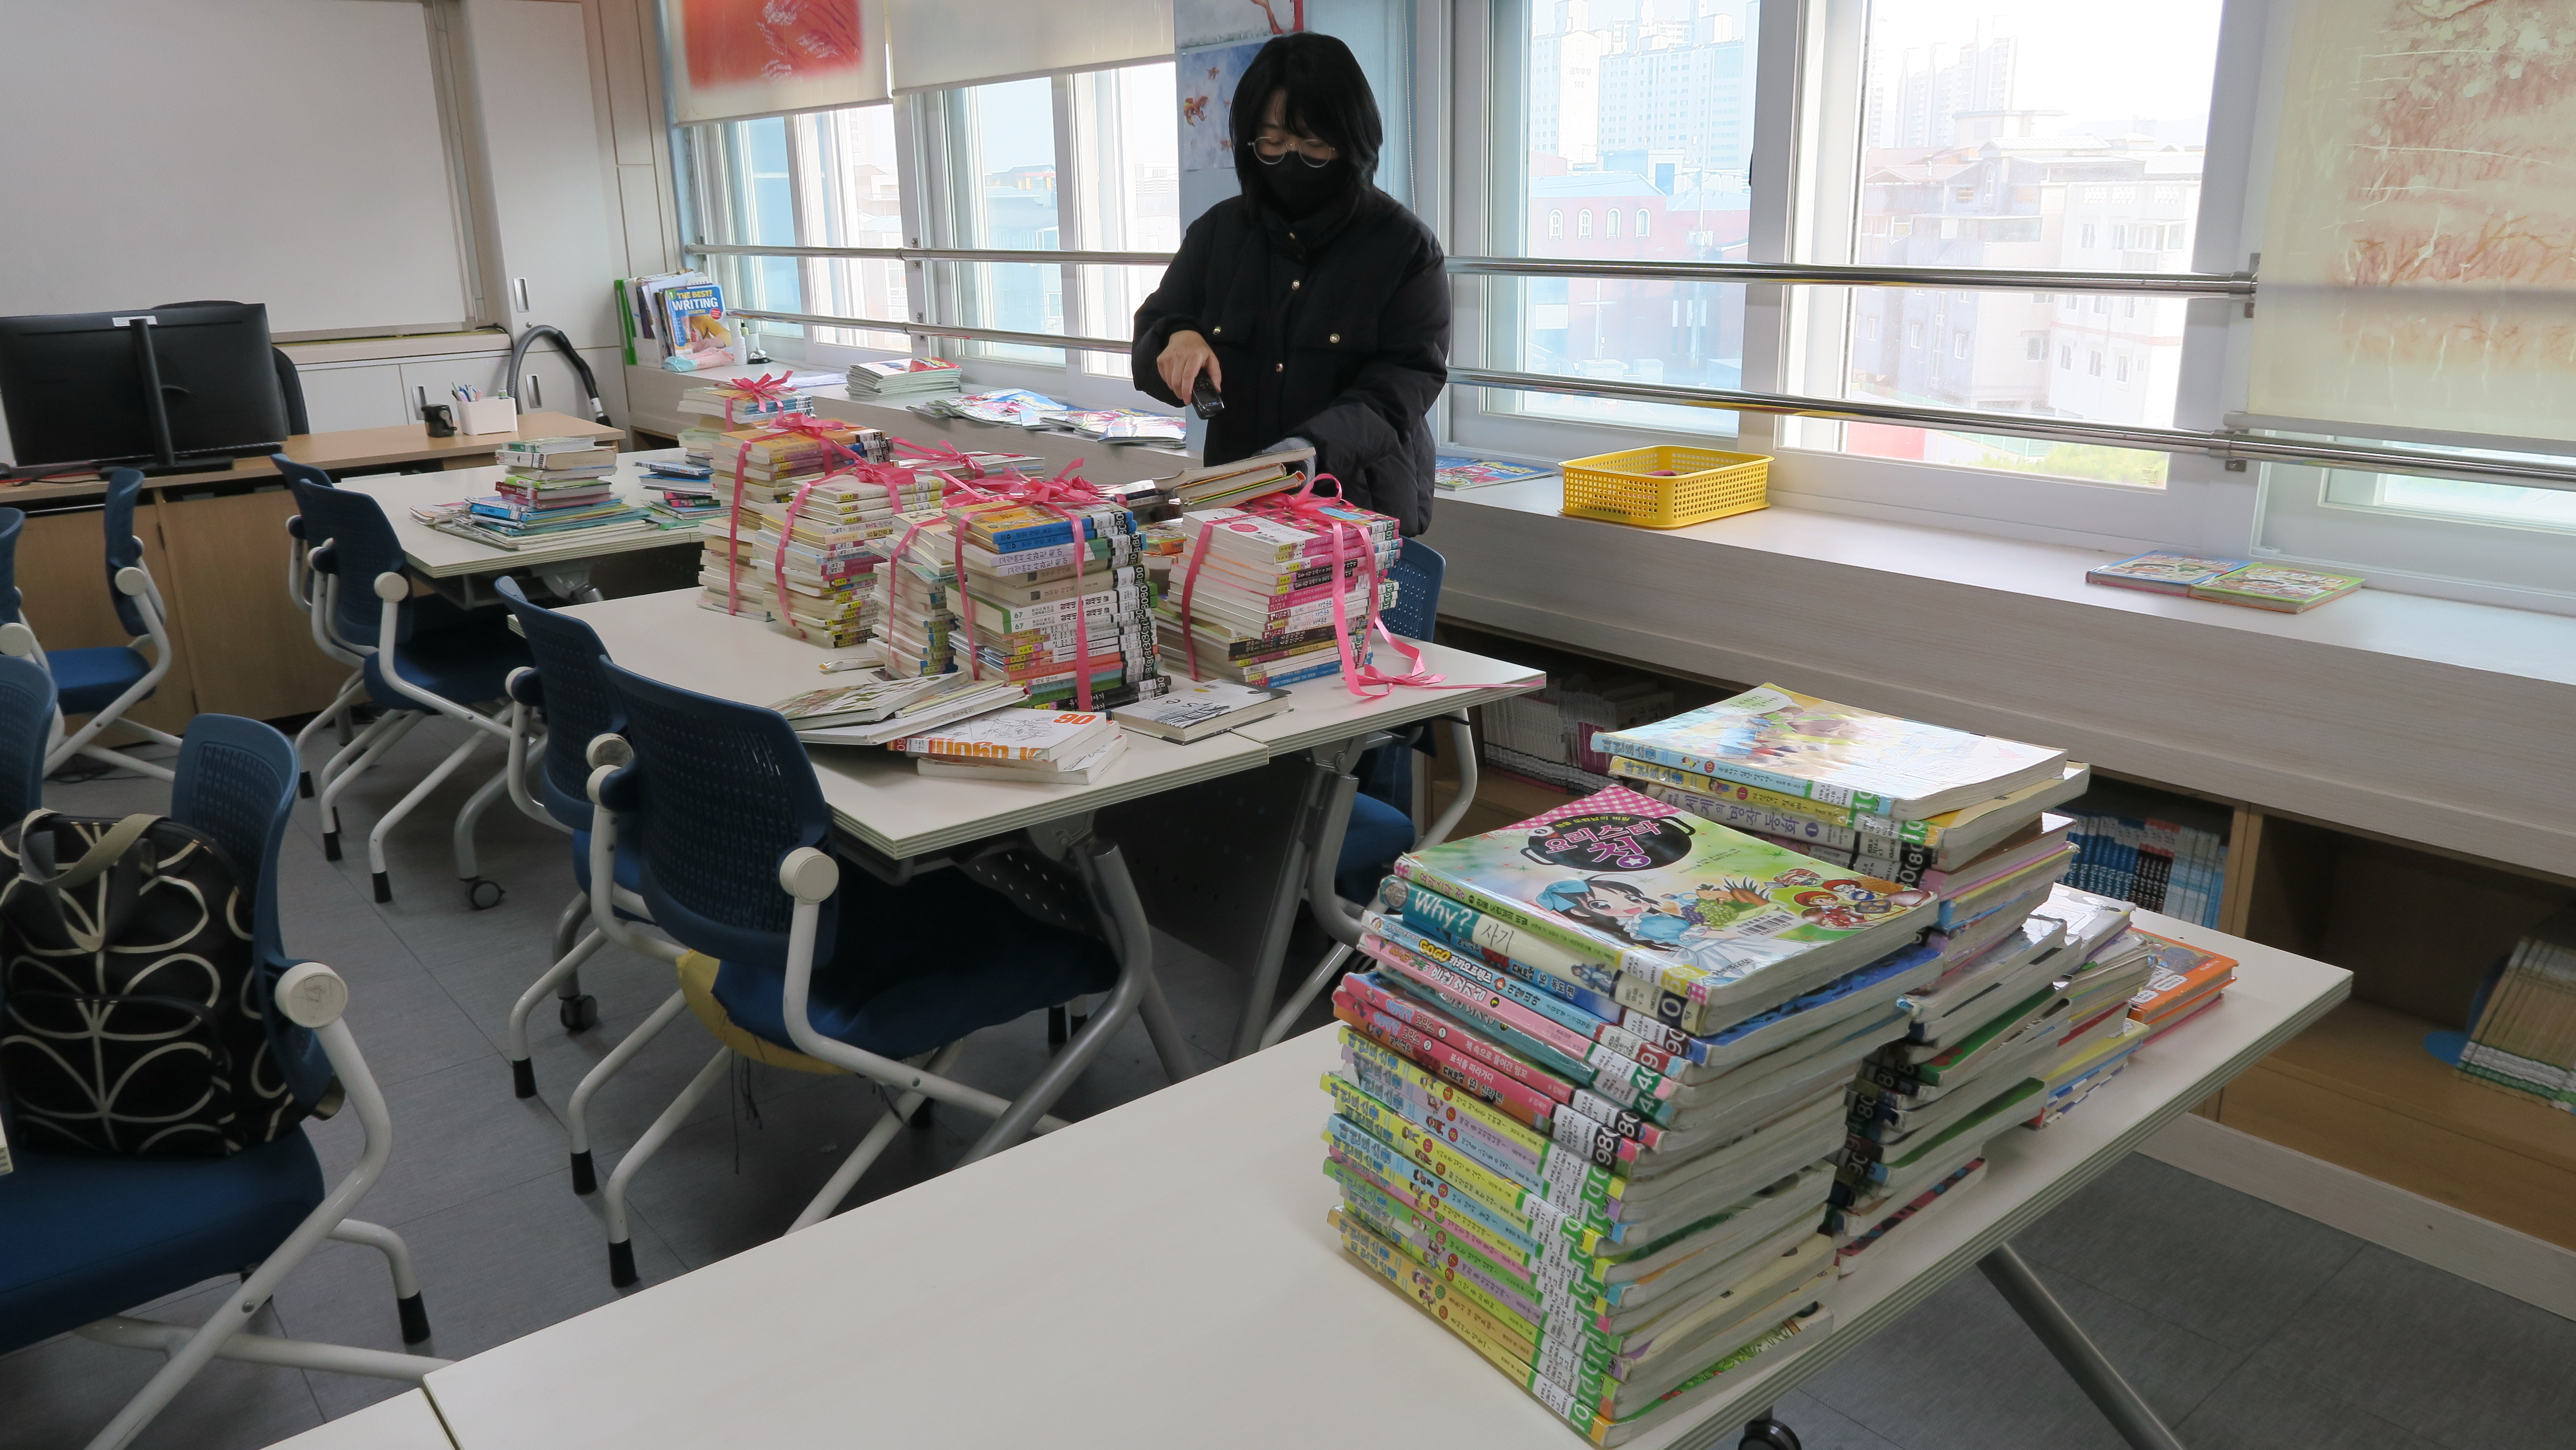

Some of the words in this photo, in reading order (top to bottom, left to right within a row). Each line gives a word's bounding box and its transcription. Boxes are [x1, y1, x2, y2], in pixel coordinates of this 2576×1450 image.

[671, 298, 718, 311] WRITING
[692, 290, 712, 298] BEST!
[1091, 693, 1104, 702] 야기
[1091, 703, 1105, 711] 야기
[1054, 714, 1097, 725] 90
[1685, 794, 1725, 821] 세계의
[1727, 802, 1761, 828] 명작
[1764, 809, 1799, 837] 동화
[1545, 820, 1661, 854] 요리스타
[1418, 872, 1453, 897] 요리스타
[1413, 888, 1473, 937] Why?
[1479, 918, 1515, 956] 사기
[1417, 937, 1452, 967] GOGO
[1449, 953, 1493, 985] 카카오프렌즈
[1538, 973, 1547, 986] 16
[1449, 1052, 1468, 1071] 표식을
[1468, 1062, 1494, 1085] 따라가다
[1465, 1039, 1473, 1052] 책
[1473, 1044, 1492, 1062] 속으로
[1492, 1053, 1514, 1073] 들어간
